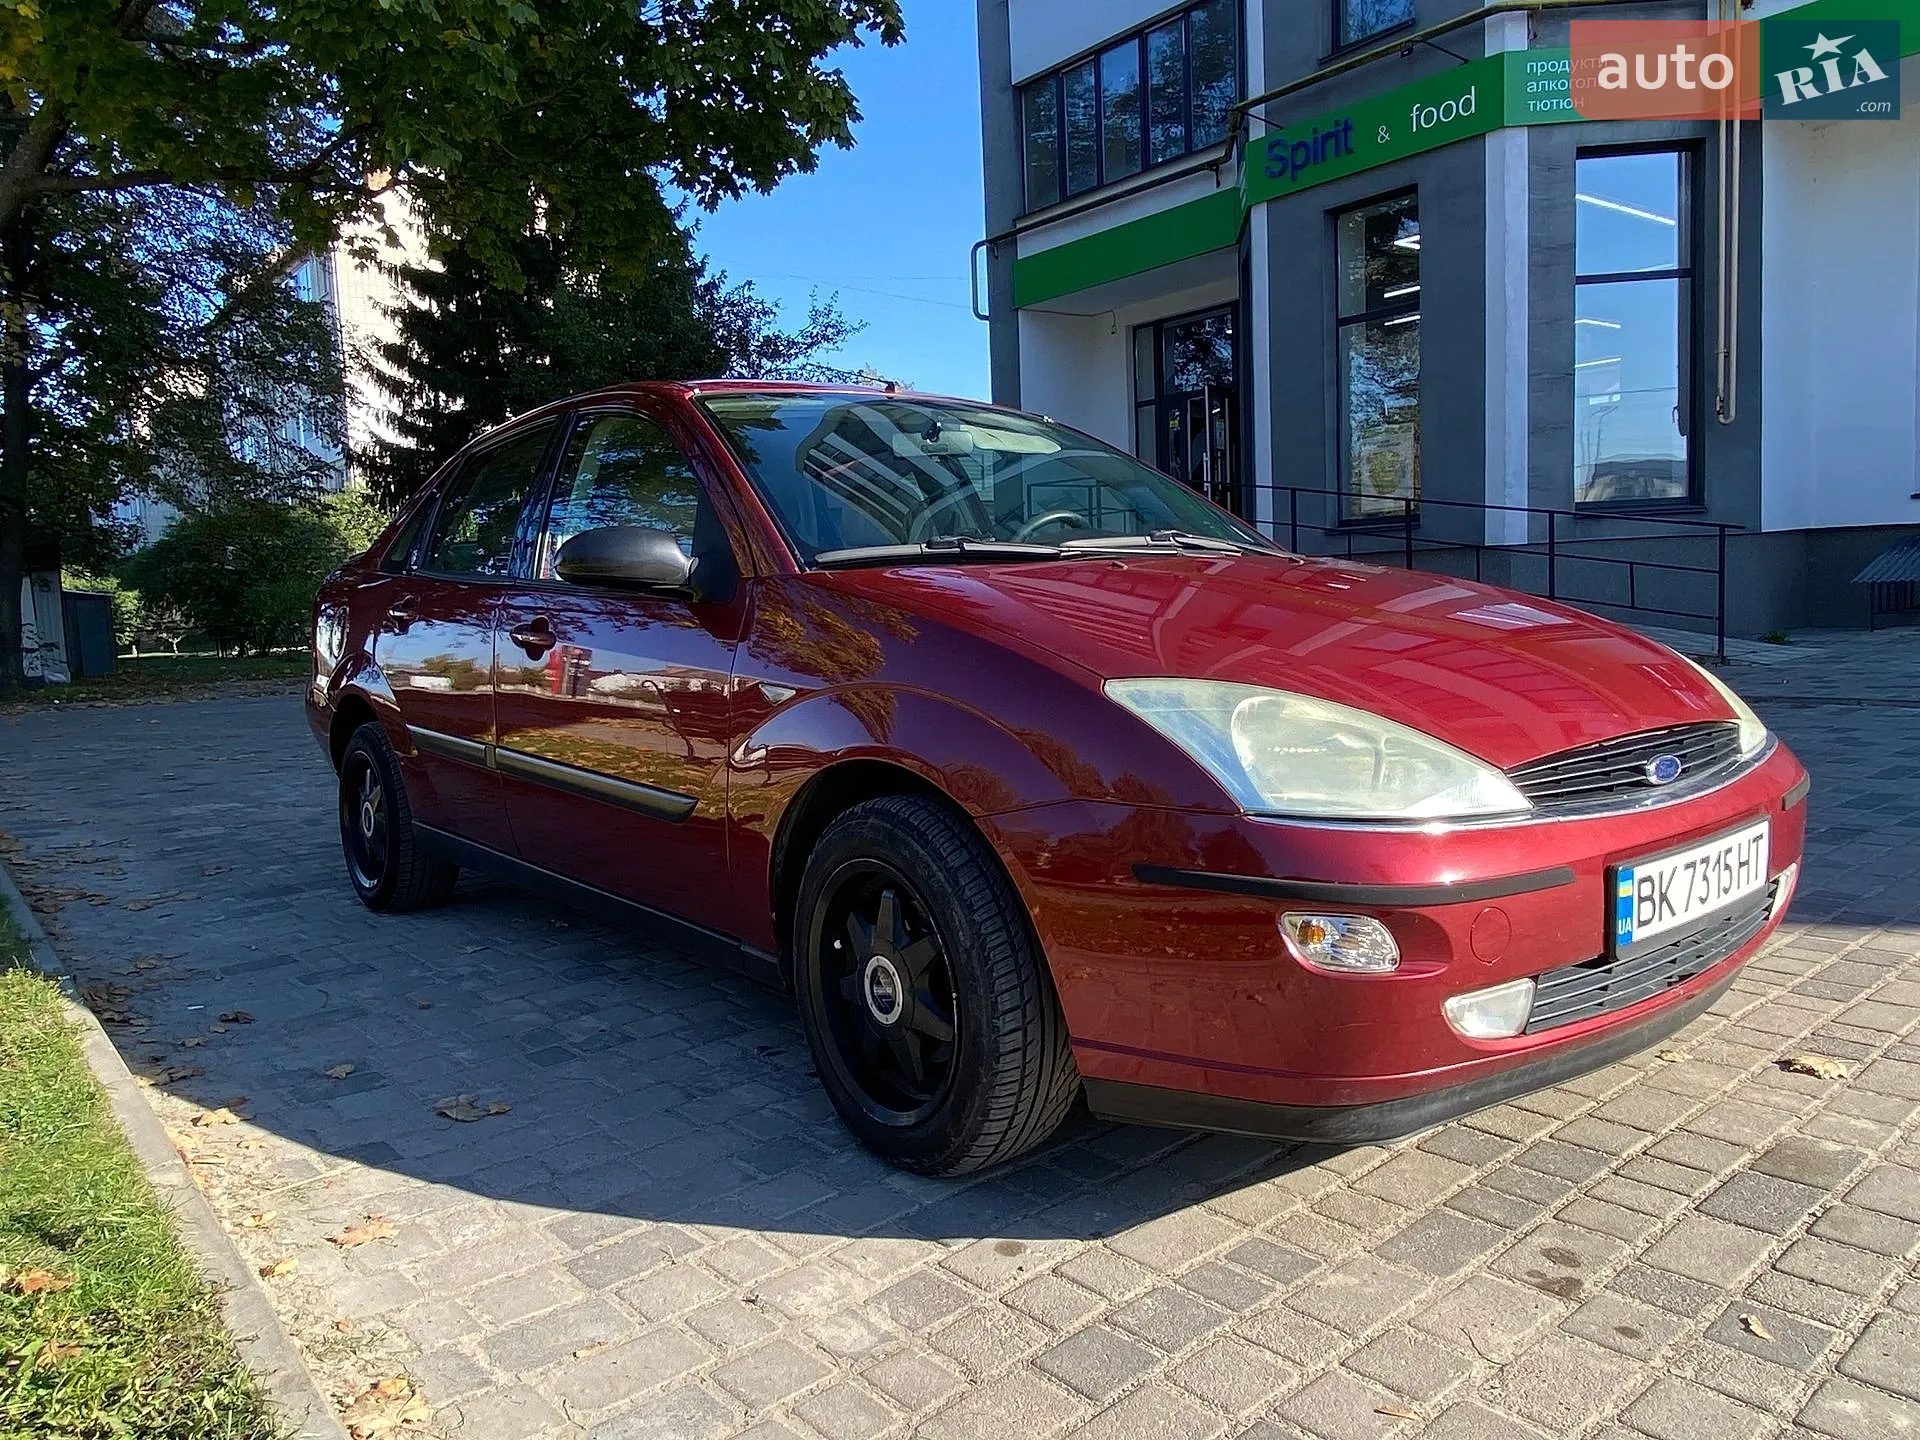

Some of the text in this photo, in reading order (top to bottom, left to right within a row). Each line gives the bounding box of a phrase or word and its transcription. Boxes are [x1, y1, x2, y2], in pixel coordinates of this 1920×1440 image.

[1526, 77, 1601, 93] алкогол
[1527, 97, 1584, 112] тютюн
[1264, 86, 1476, 181] Spirit & food
[1618, 917, 1632, 935] UA
